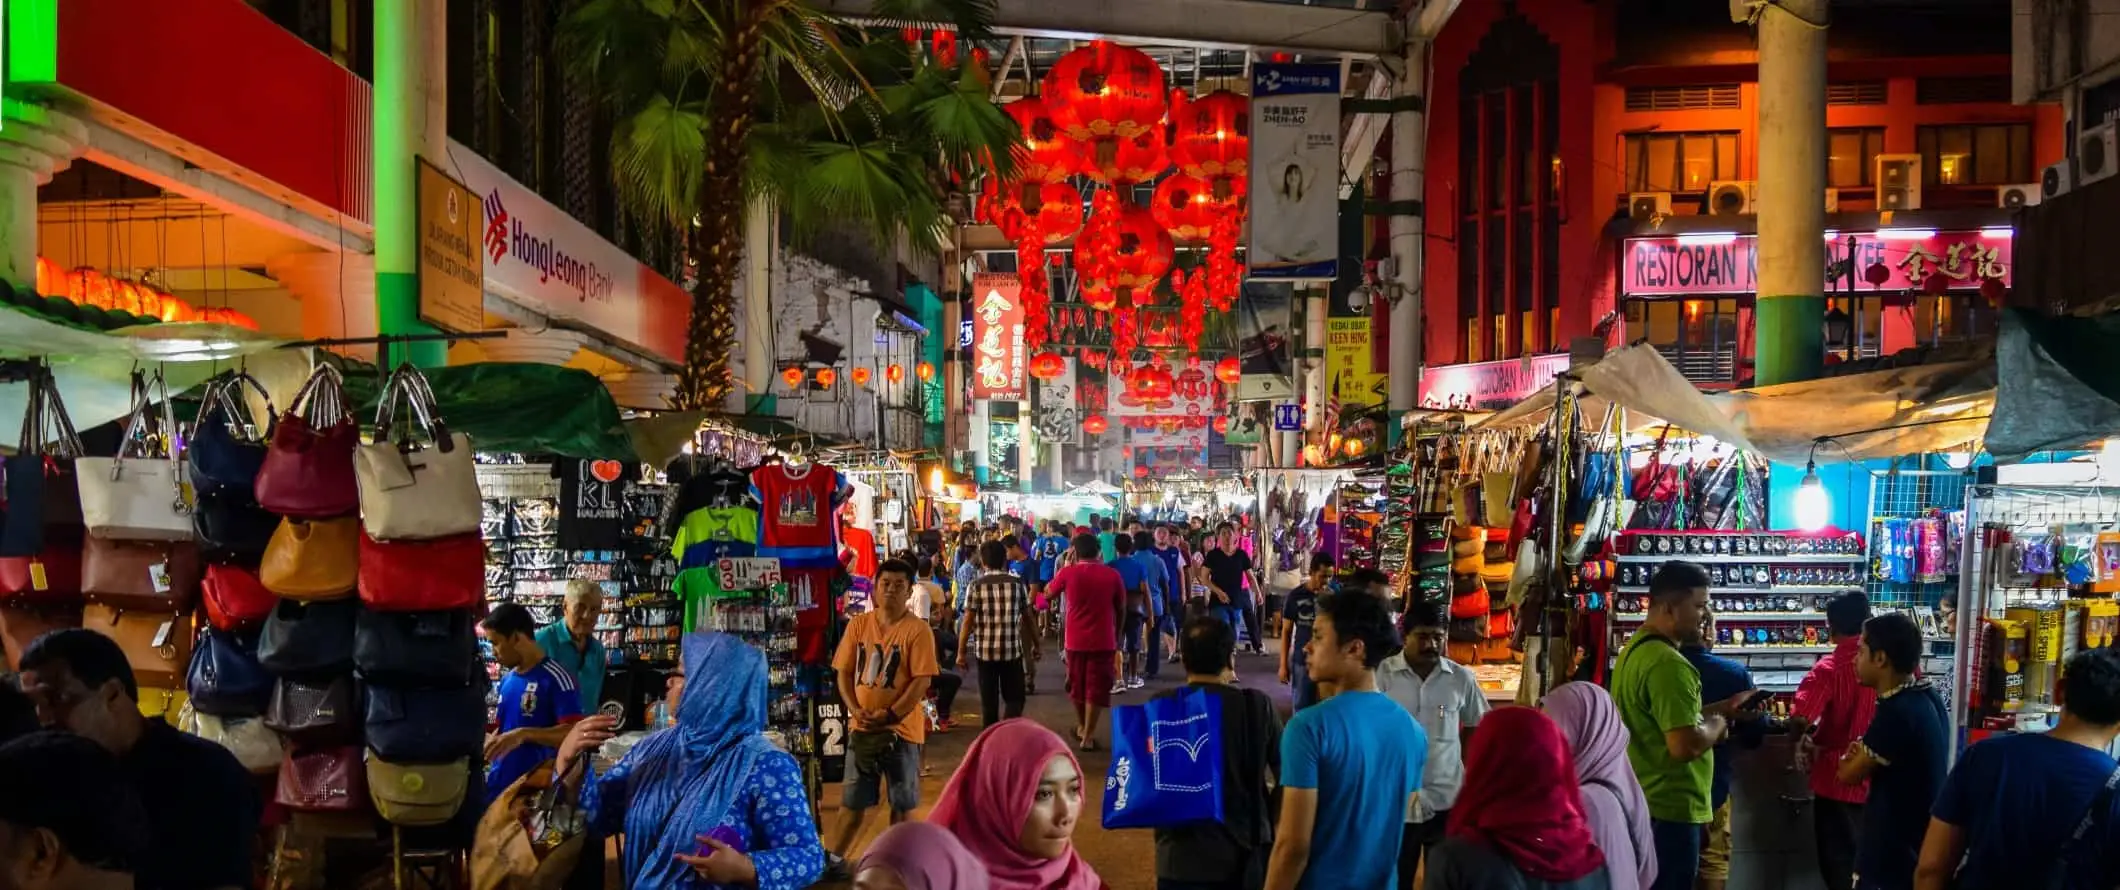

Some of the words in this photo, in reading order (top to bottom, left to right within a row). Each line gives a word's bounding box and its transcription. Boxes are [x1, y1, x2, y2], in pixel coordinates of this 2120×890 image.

[1635, 243, 1737, 287] RESTORAN
[588, 261, 614, 304] Bank
[1329, 331, 1349, 344] KEEN
[722, 572, 735, 590] 3
[818, 703, 842, 718] USA
[820, 718, 845, 756] 2
